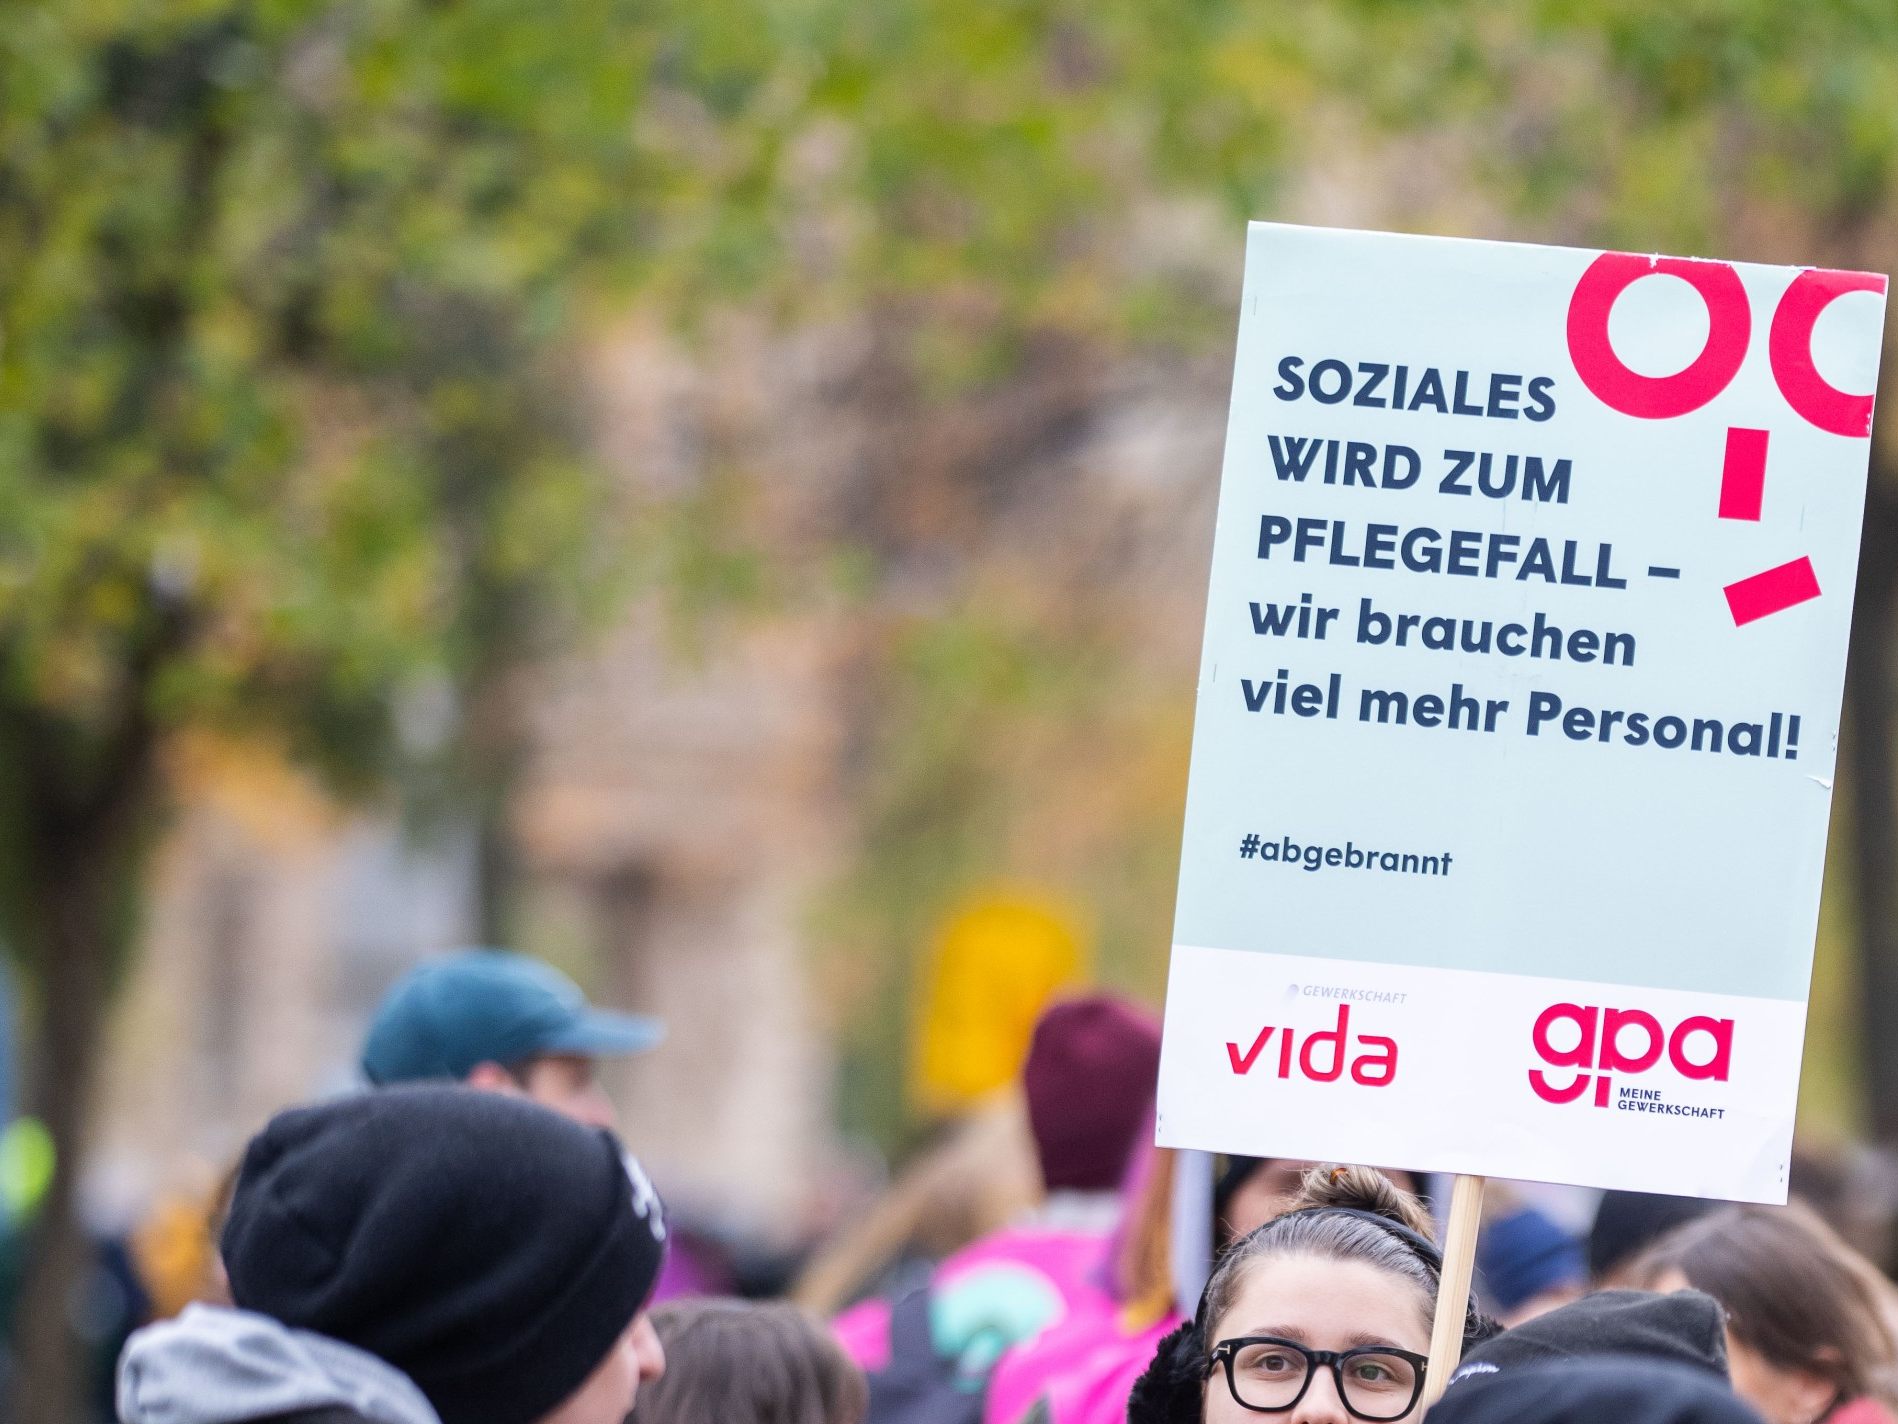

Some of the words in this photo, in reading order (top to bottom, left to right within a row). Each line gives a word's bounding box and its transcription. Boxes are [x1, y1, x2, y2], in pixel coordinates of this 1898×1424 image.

[1272, 355, 1557, 422] SOZIALES
[1267, 434, 1422, 490] WIRD
[1438, 449, 1573, 505] ZUM
[1257, 514, 1628, 590] PFLEGEFALL
[1248, 593, 1341, 640] wir
[1356, 597, 1637, 668] brauchen
[1240, 670, 1342, 719] viel
[1358, 683, 1510, 733] mehr
[1526, 690, 1802, 760] Personal!
[1239, 832, 1453, 876] #abgebrannt
[1303, 984, 1408, 1005] GEWERKSCHAFT
[1226, 1003, 1399, 1088] vida
[1527, 1002, 1735, 1108] gpa
[1617, 1099, 1726, 1120] GEWERKSCHAFT
[1618, 1087, 1662, 1101] MEINE
